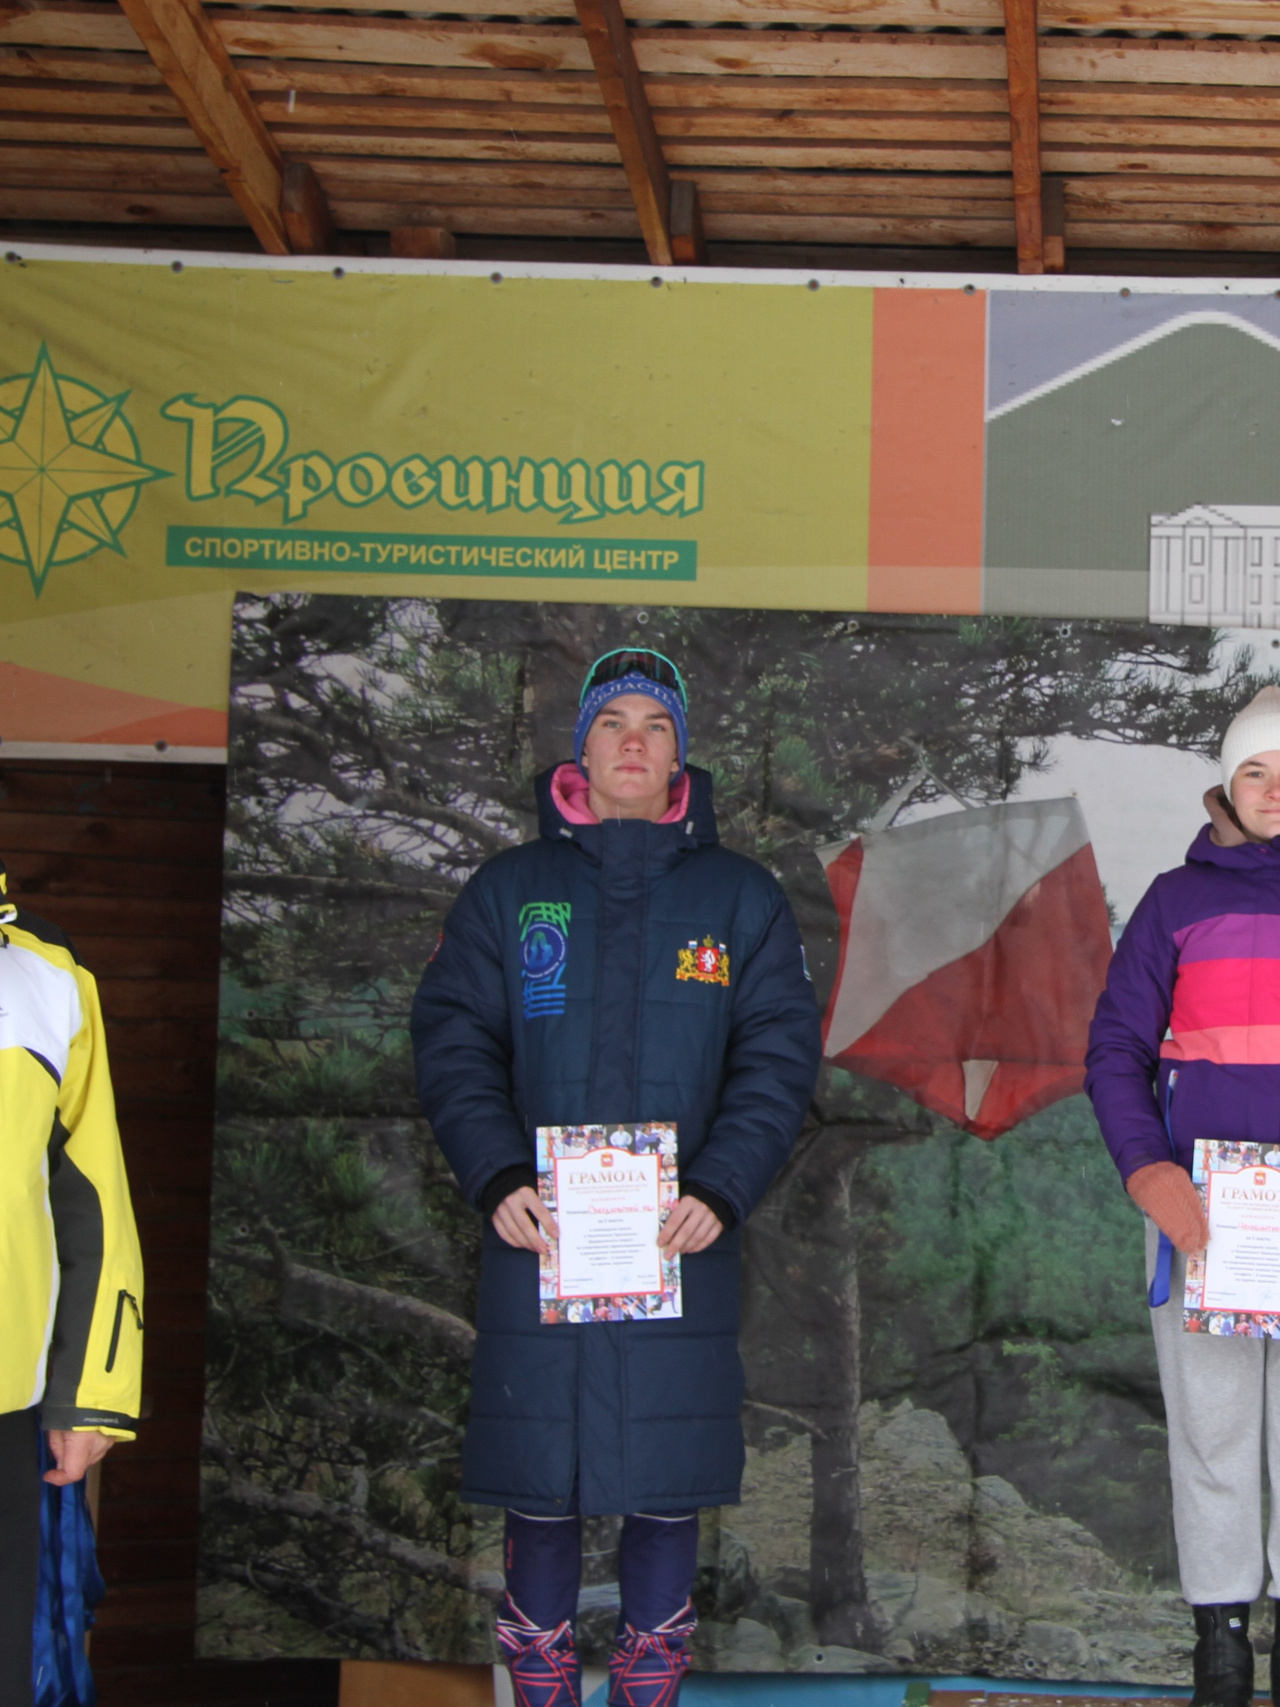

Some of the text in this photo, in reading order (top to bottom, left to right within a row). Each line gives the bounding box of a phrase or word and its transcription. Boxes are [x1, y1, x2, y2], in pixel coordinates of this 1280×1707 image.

[160, 394, 704, 525] Провинция
[185, 536, 680, 572] СПОРТИВНО-ТУРИСТИЧЕСКИЙ ЦЕНТР
[568, 1170, 647, 1185] ГРАМОТА
